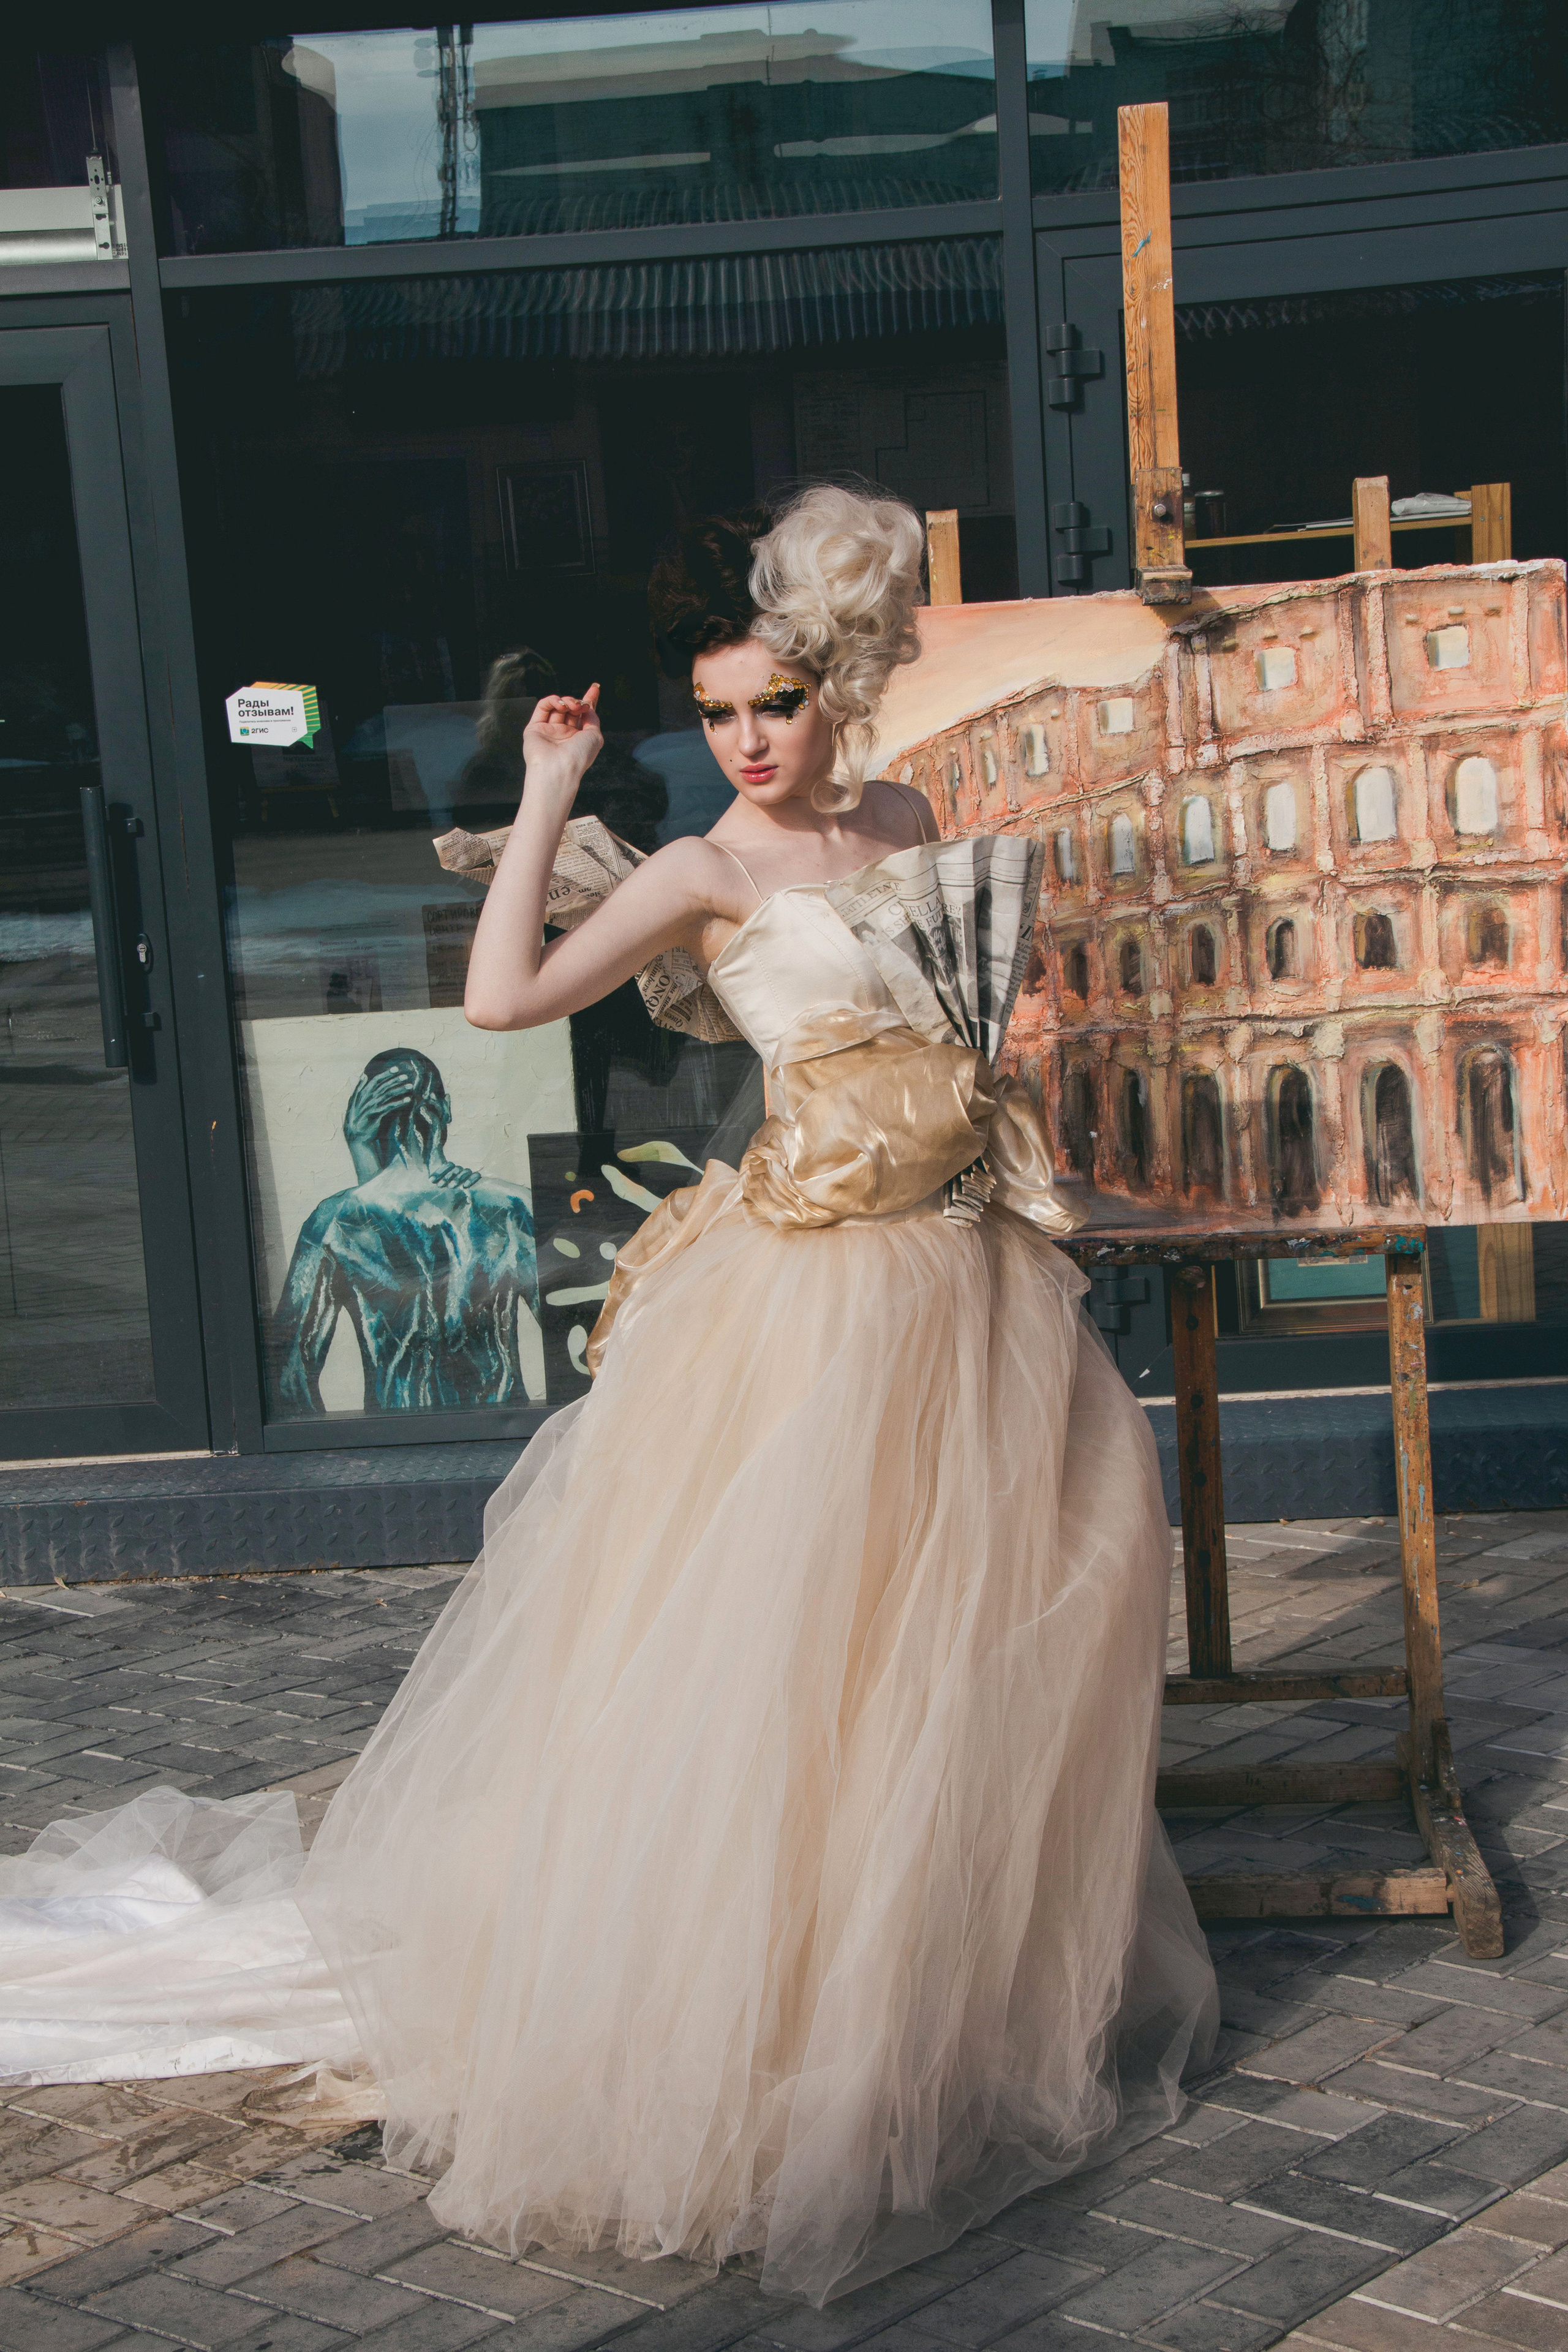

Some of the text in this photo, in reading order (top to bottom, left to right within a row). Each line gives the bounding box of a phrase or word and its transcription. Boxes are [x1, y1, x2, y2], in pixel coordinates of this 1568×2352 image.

[238, 698, 269, 709] Рады
[238, 706, 294, 717] отзывам!
[664, 1011, 683, 1027] Queen
